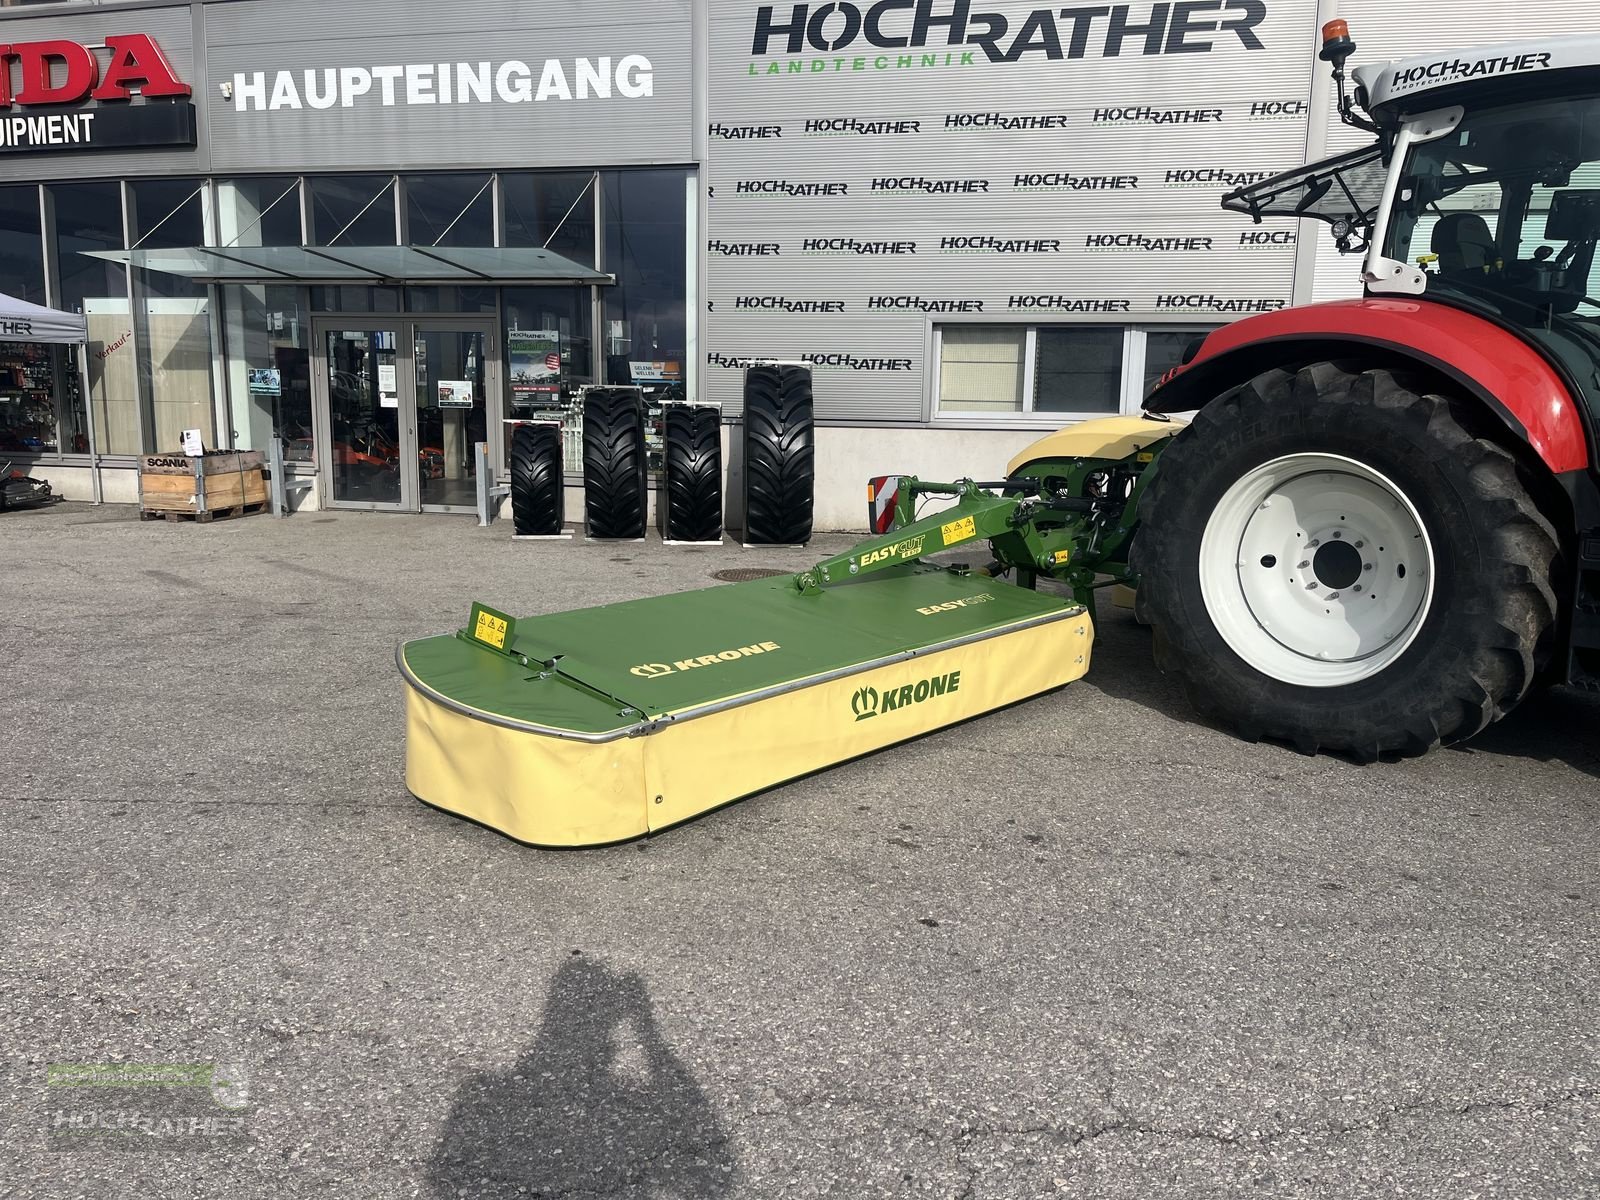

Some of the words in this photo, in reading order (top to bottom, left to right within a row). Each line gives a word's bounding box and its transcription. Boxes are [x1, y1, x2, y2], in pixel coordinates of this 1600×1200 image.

[752, 0, 1266, 63] HOCHRATHER
[748, 51, 975, 76] LANDTECHNIK
[1392, 52, 1552, 87] HOCHRATHER
[233, 54, 654, 112] HAUPTEINGANG
[1390, 74, 1460, 93] LANDTECHNIK
[944, 112, 1067, 130] HOCHRATHER
[1093, 106, 1223, 124] HOCHRATHER
[805, 118, 920, 135] HOCHRATHER
[736, 180, 848, 196] HOCHRATHER
[871, 177, 989, 194] HOCHRATHER
[1013, 173, 1138, 190] HOCHRATHER
[802, 238, 916, 254] HOCHRATHER
[940, 236, 1060, 253] HOCHRATHER
[1085, 233, 1212, 250] HOCHRATHER
[735, 296, 845, 312] HOCHRATHER
[868, 296, 984, 312] HOCHRATHER
[1008, 295, 1130, 312] HOCHRATHER
[1156, 294, 1285, 312] HOCHRATHER
[0, 321, 32, 335] HER
[801, 353, 912, 370] HOCHRATHER
[147, 458, 188, 468] SCANIA
[861, 534, 926, 567] EASYCUT
[916, 592, 995, 616] EASYCUT
[673, 640, 781, 671] KRONE
[881, 671, 961, 714] KRONE
